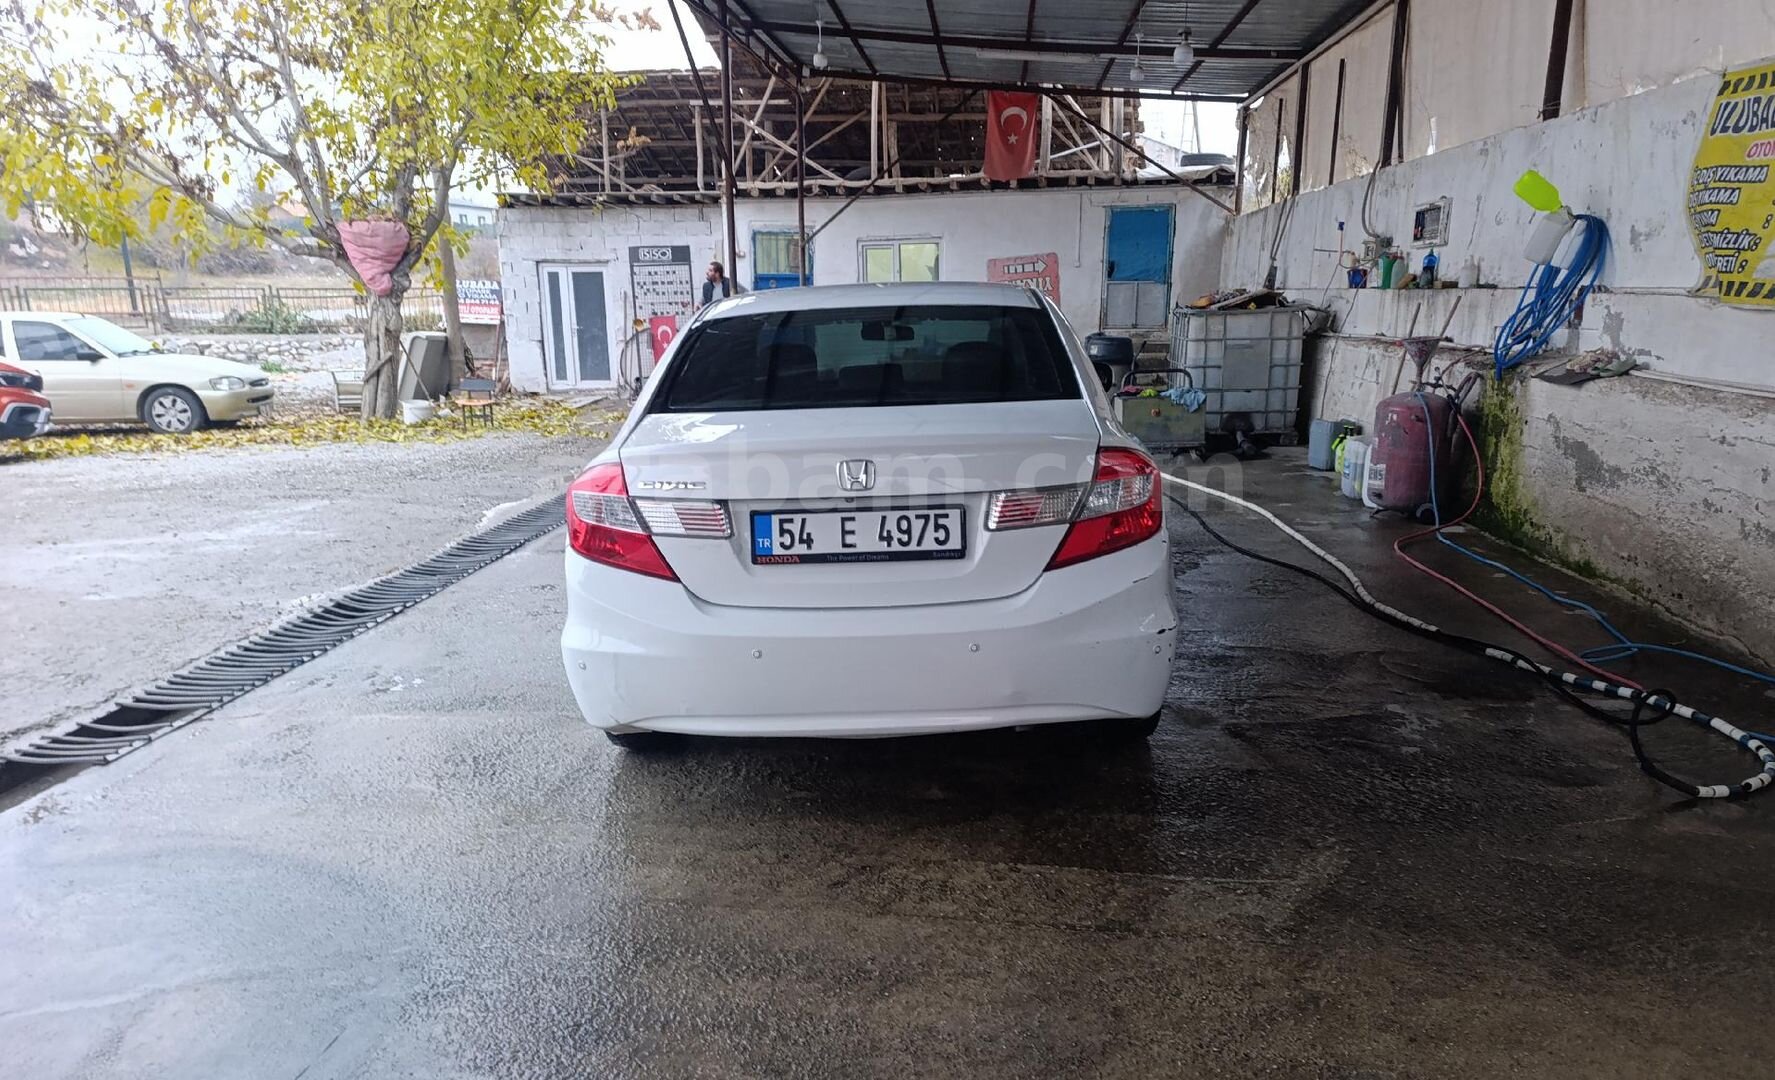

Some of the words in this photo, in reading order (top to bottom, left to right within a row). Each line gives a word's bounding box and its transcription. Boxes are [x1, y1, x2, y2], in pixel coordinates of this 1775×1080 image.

[1710, 94, 1775, 137] ULUBA
[1714, 165, 1768, 183] YIKAMA
[778, 517, 814, 550] 54
[840, 516, 857, 548] E
[878, 513, 950, 548] 4975
[757, 538, 771, 548] TR
[757, 556, 800, 564] HONDA
